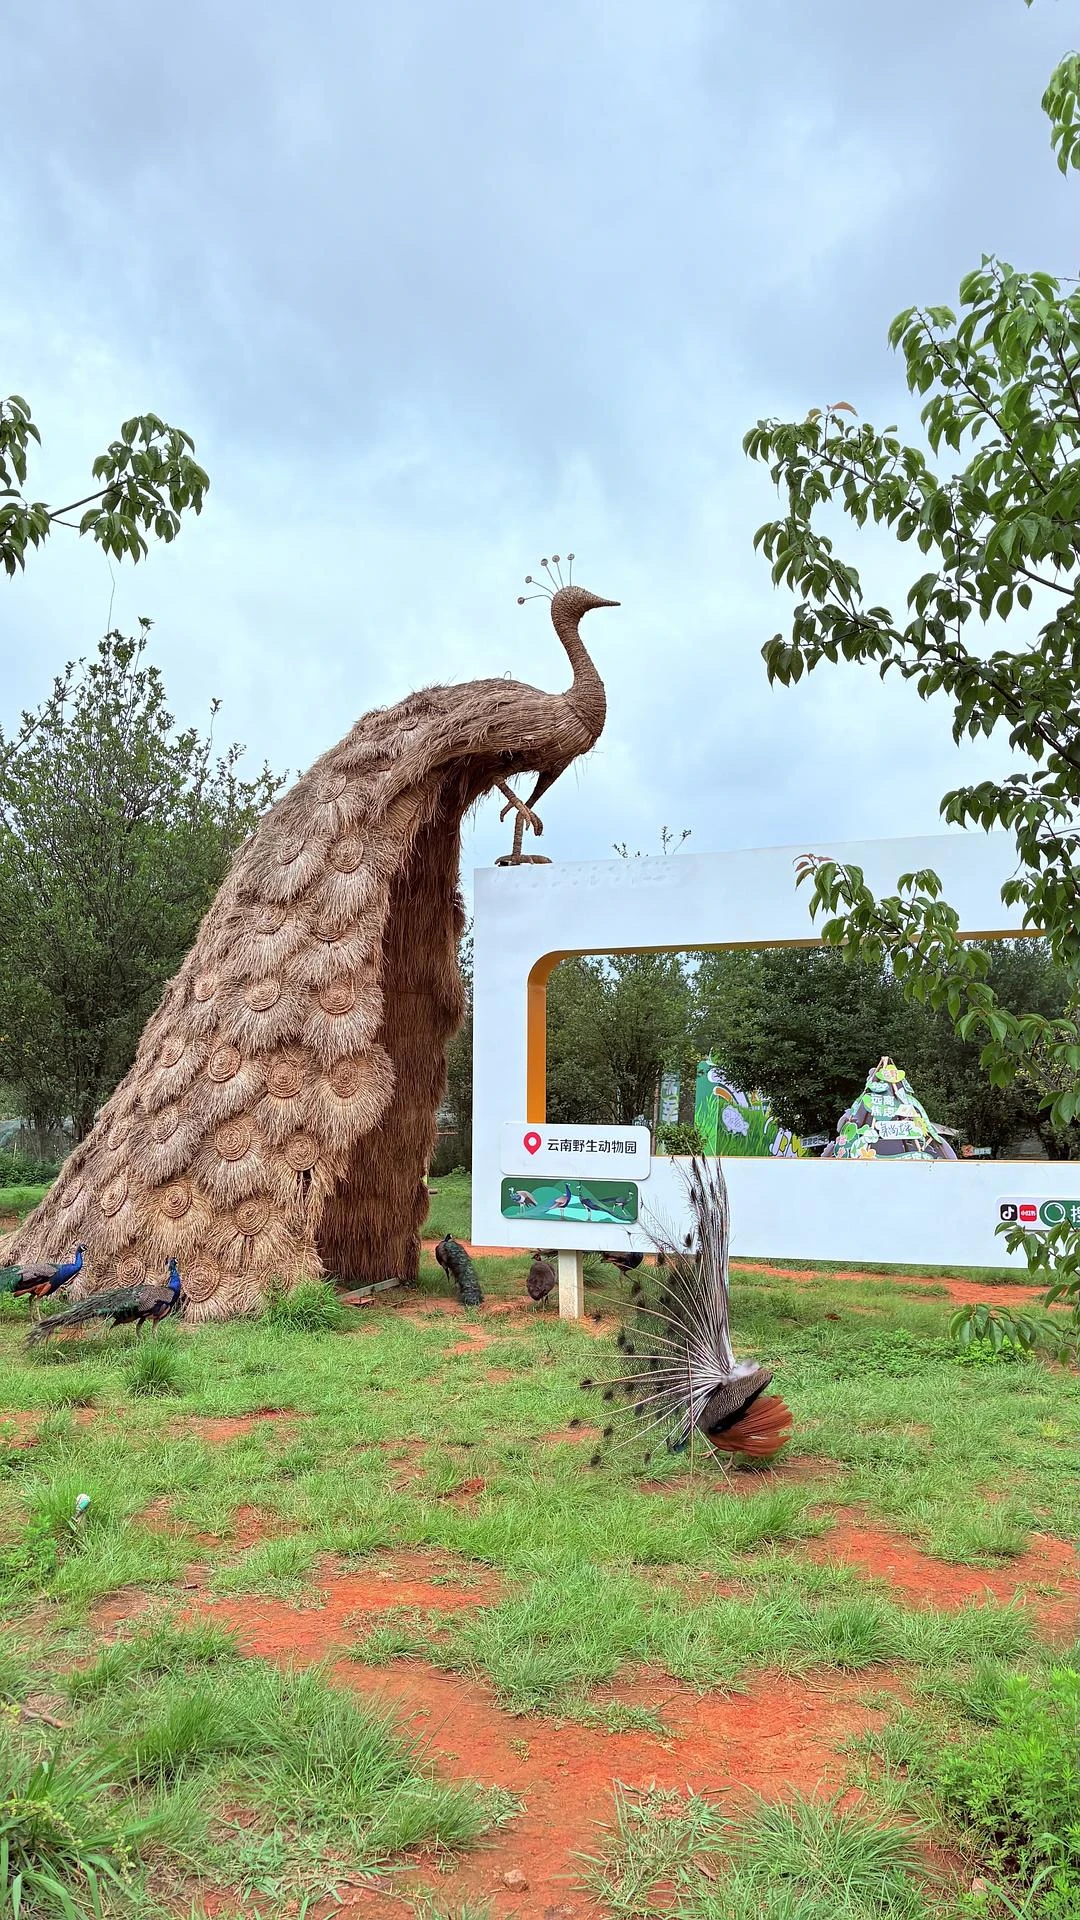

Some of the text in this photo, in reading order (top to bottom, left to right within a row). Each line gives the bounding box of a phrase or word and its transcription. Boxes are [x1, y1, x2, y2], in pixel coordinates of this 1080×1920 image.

[547, 1138, 637, 1154] 云南野生动物园
